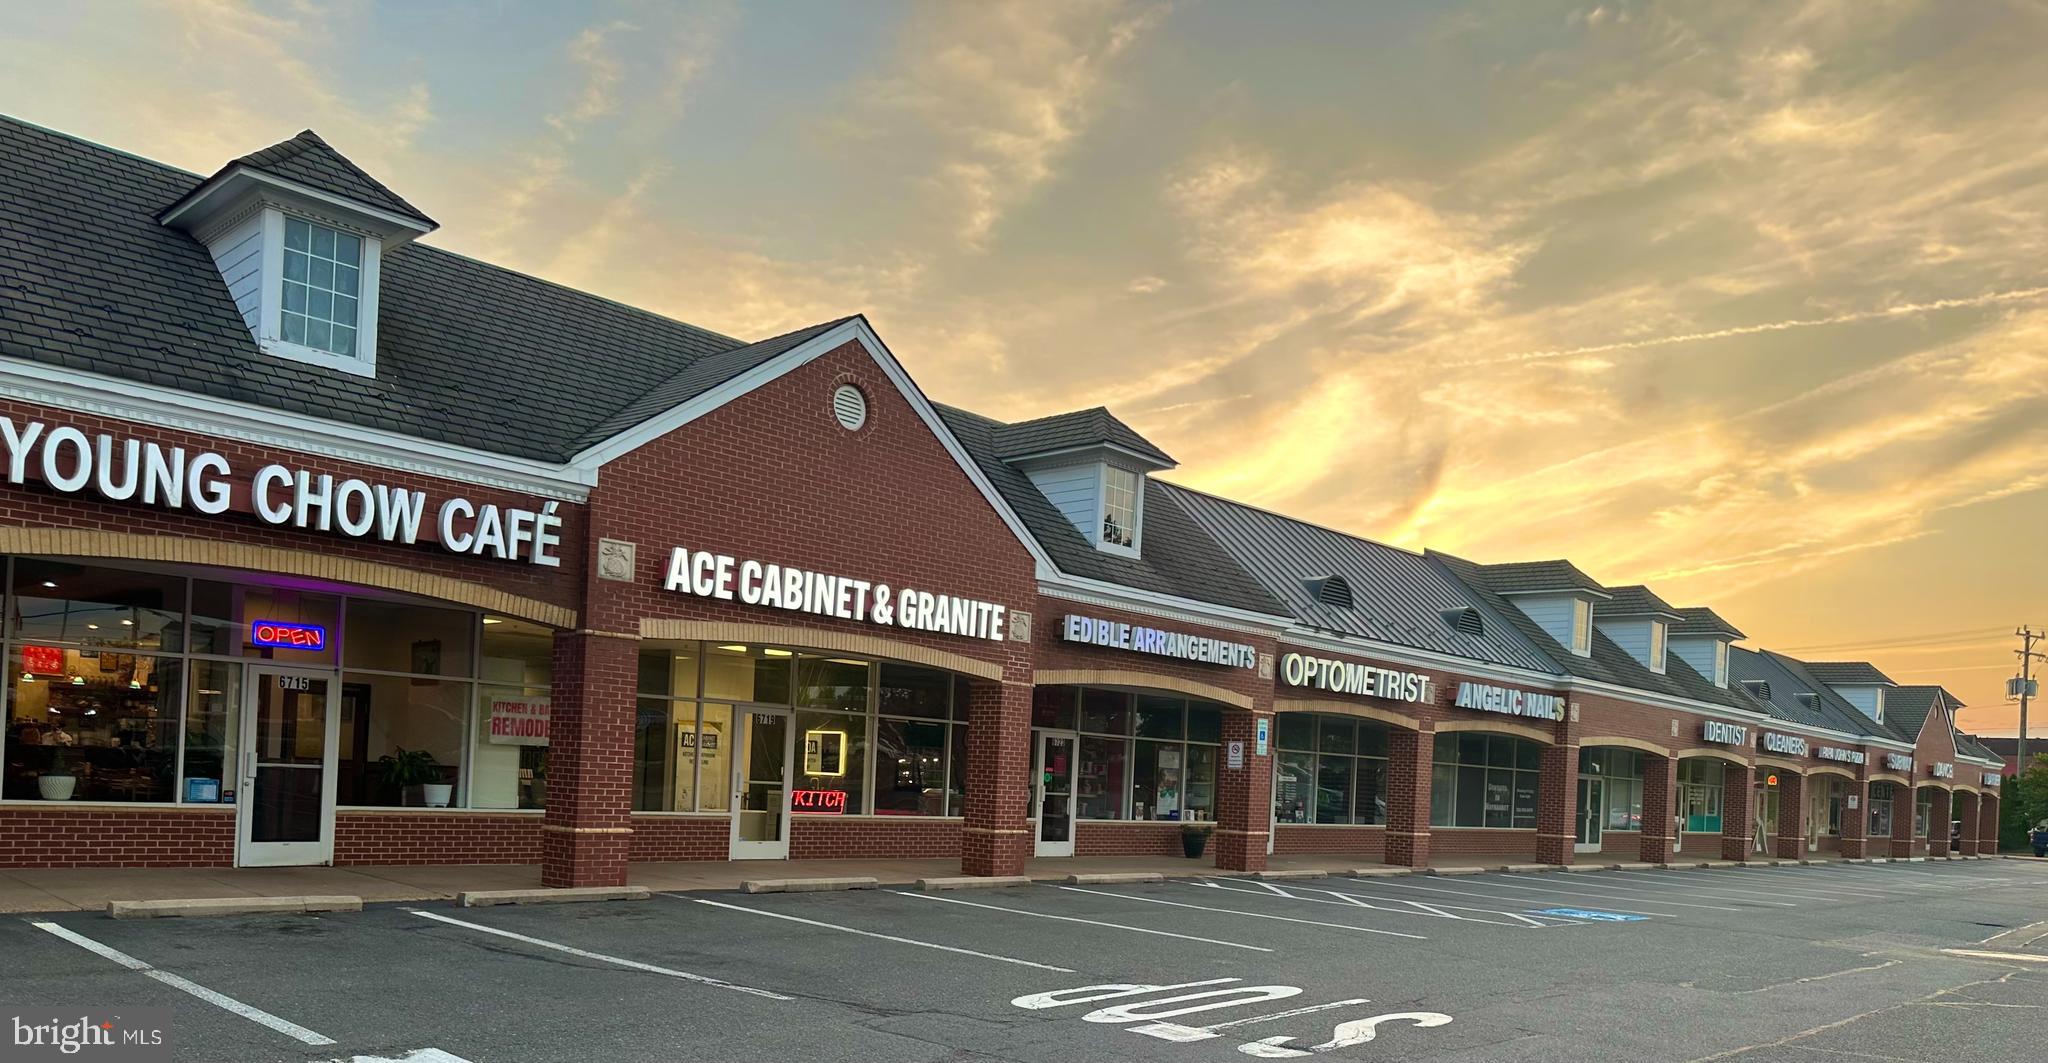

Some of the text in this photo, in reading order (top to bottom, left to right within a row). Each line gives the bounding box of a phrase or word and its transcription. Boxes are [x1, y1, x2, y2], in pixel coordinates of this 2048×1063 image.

[0, 416, 562, 567] YOUNG CHOW CAFÉ
[664, 547, 1006, 641] ACE CABINET & GRANITE
[258, 626, 321, 647] OPEN
[1064, 614, 1256, 669] EDIBLE ARRANGEMENTS
[279, 676, 308, 690] 6715
[1280, 653, 1430, 703] OPTOMETRIST
[492, 701, 528, 714] KITCHEN
[531, 705, 537, 715] &
[1455, 682, 1566, 722] ANGELIC NAILS
[1704, 720, 1747, 746] DENTIST
[1763, 732, 1806, 756] CLEANERS
[794, 791, 846, 807] KITCH
[1010, 977, 1454, 1058] STOP
